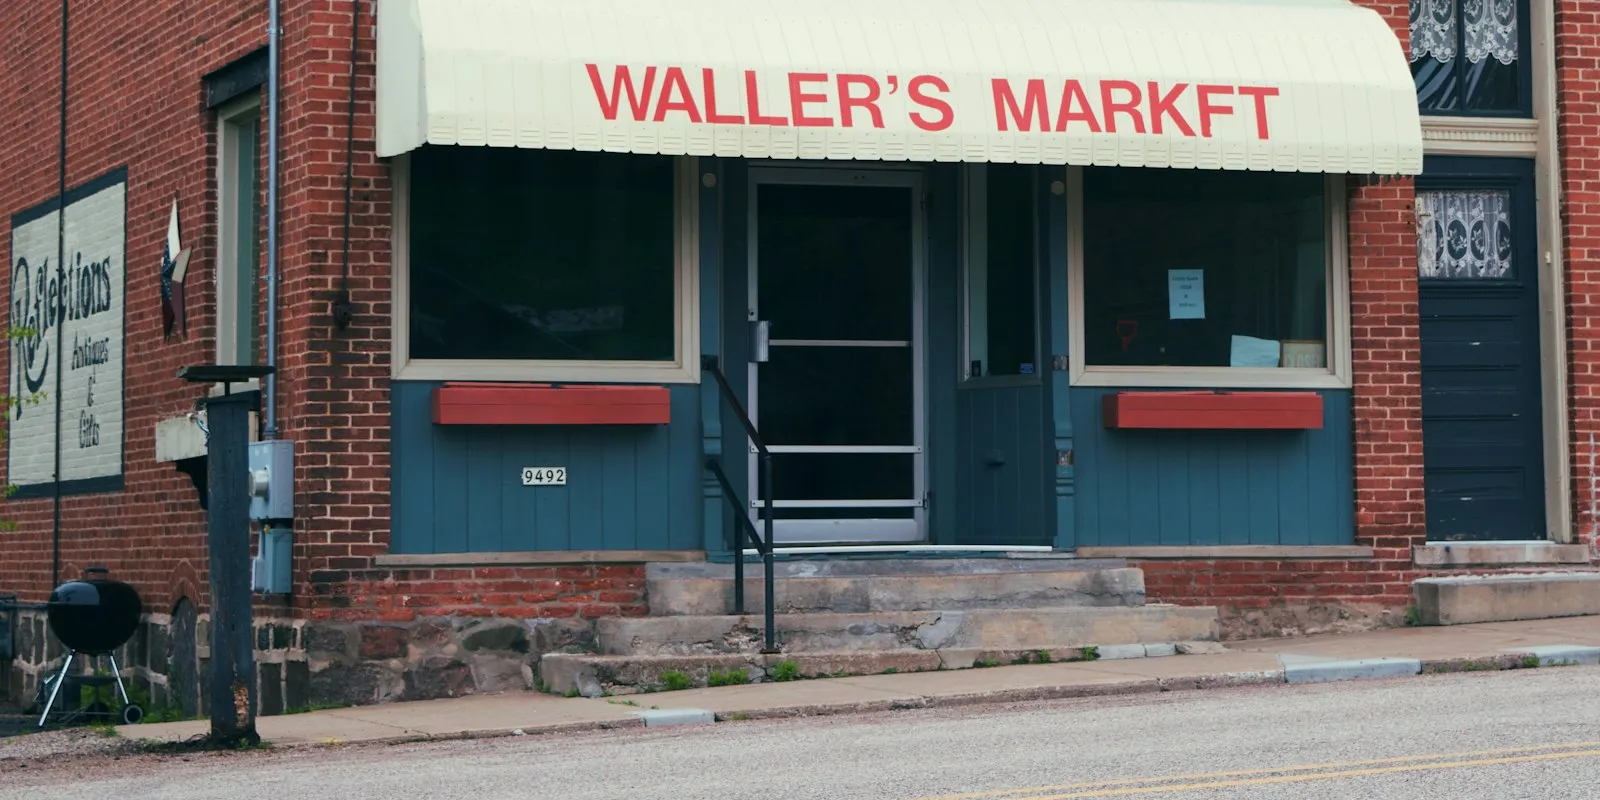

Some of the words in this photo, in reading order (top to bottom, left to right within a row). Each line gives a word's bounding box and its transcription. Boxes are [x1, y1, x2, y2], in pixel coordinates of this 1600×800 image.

[585, 63, 955, 132] WALLER'S
[71, 330, 109, 384] Antiques
[87, 375, 96, 408] &
[79, 409, 100, 449] Gifts
[525, 469, 564, 483] 9492
